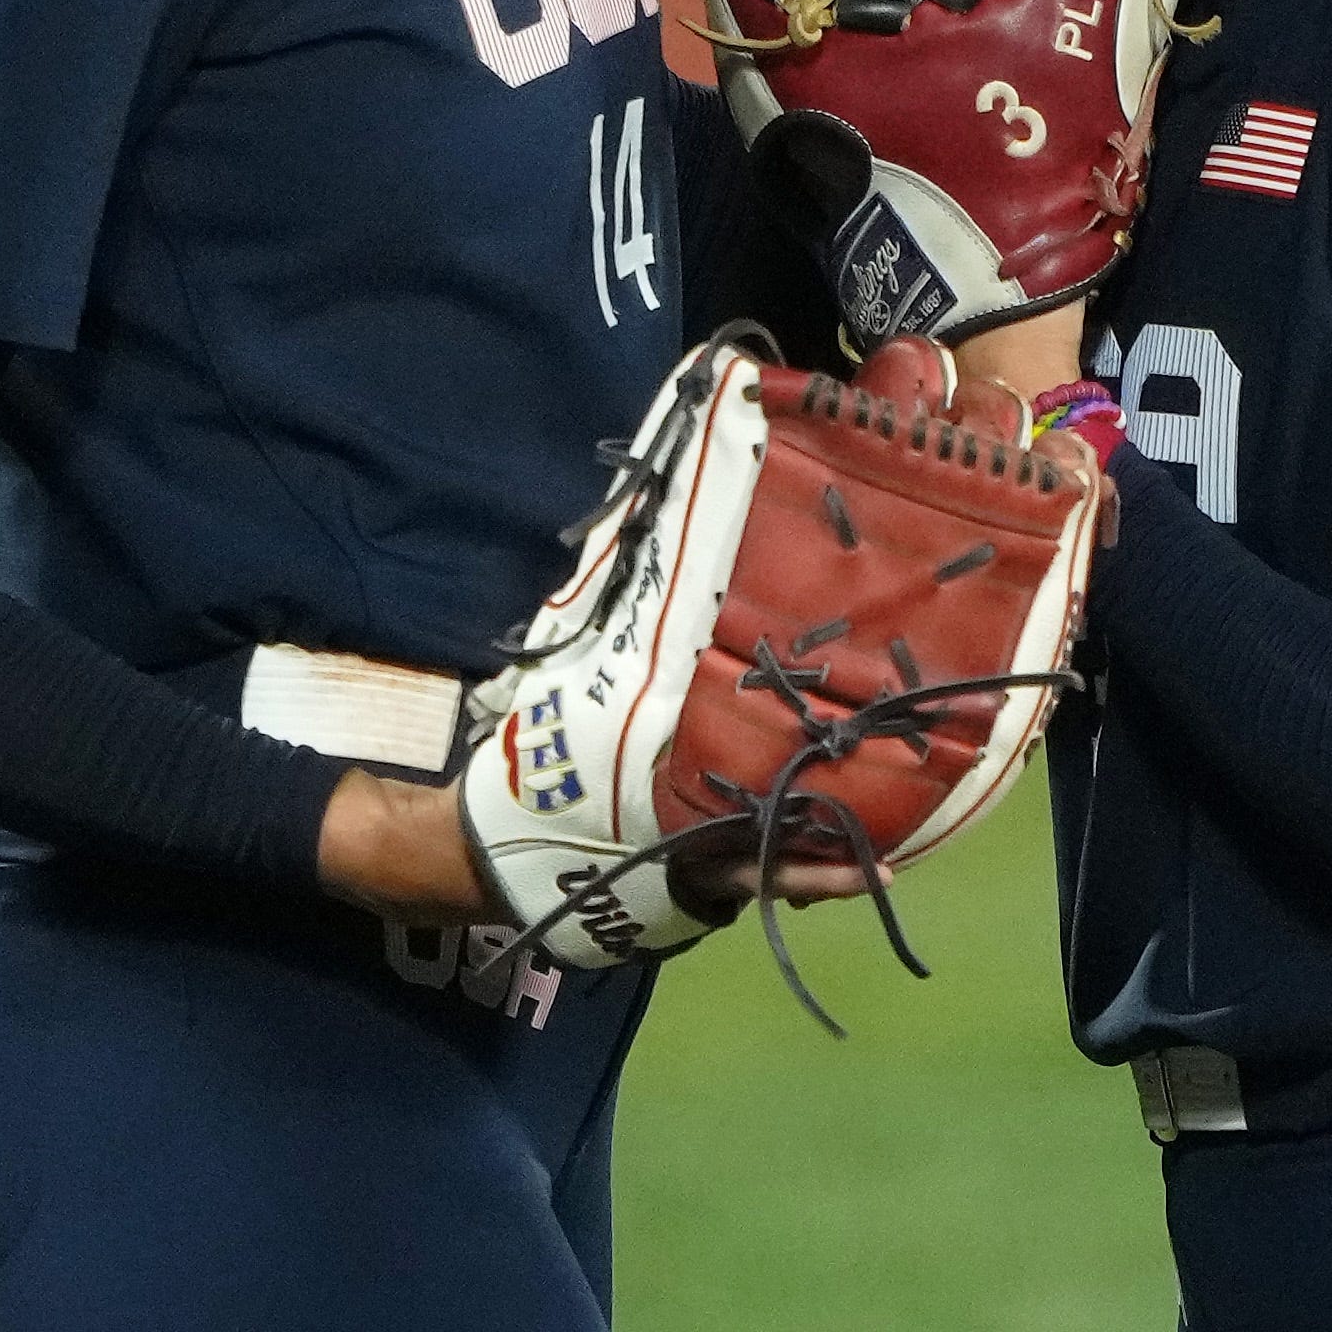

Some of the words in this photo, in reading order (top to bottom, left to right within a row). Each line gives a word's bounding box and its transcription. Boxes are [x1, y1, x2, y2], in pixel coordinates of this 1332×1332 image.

[975, 79, 1048, 159] 3
[589, 96, 661, 329] 14
[845, 237, 902, 336] lings
